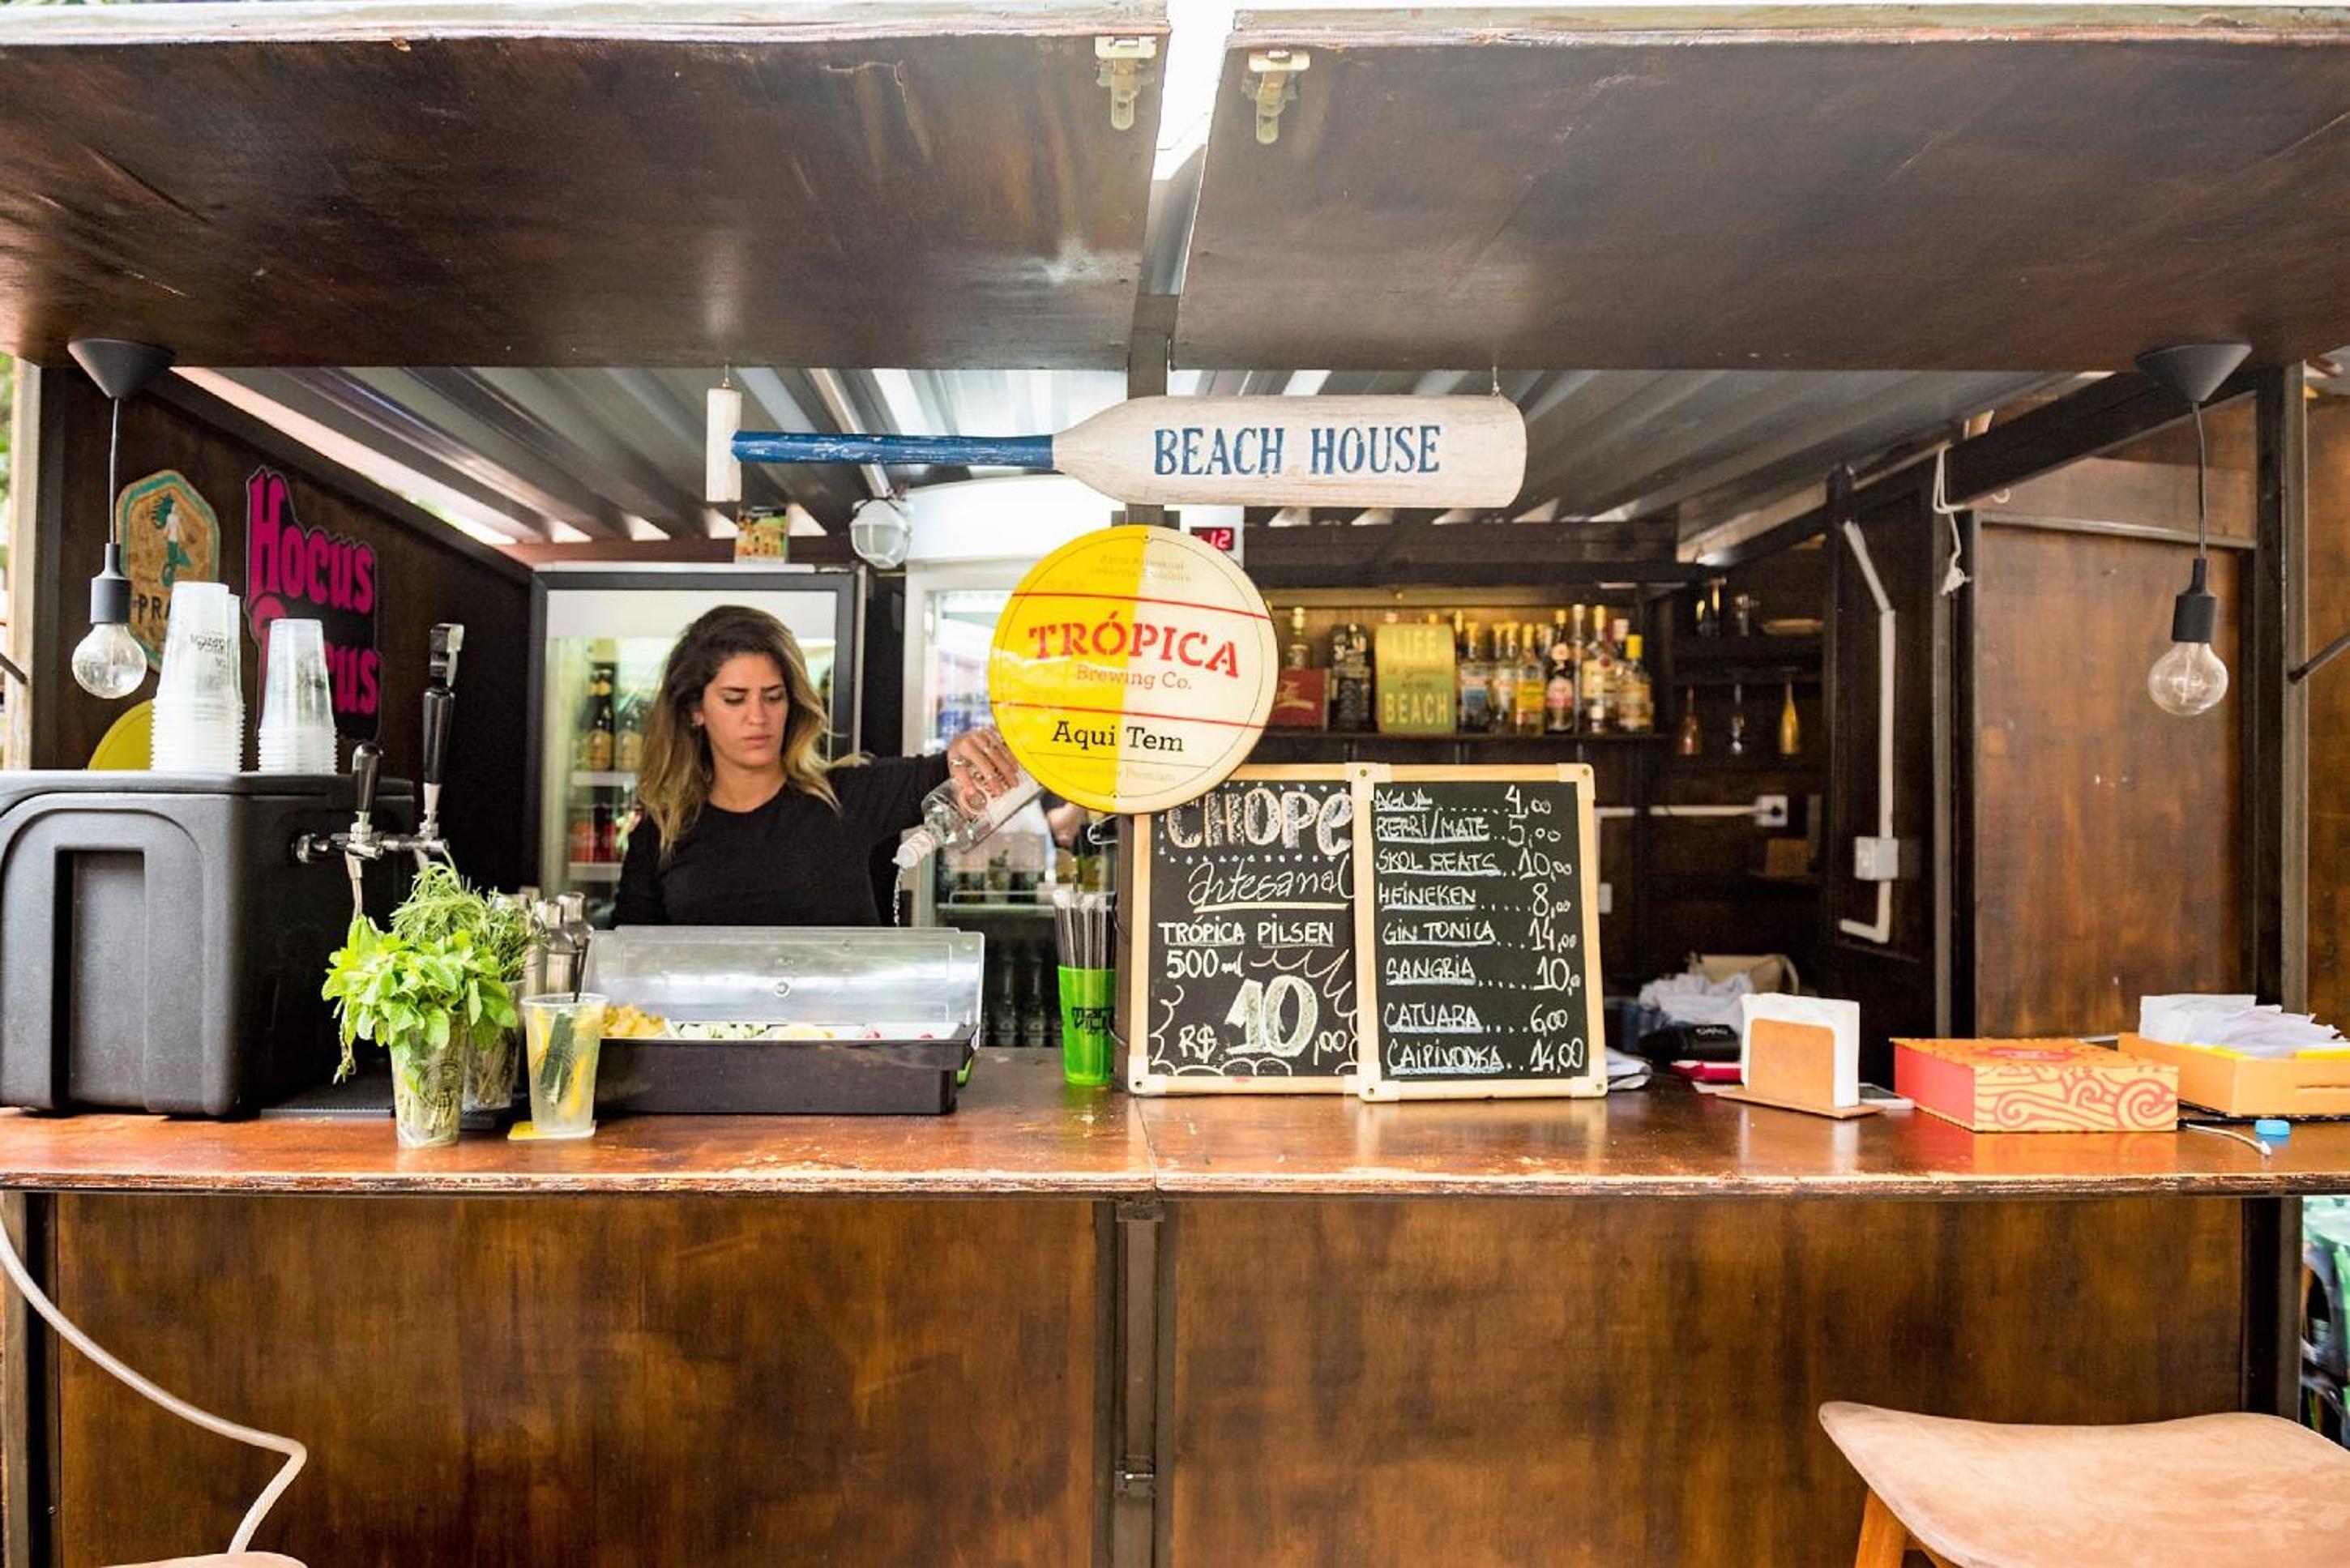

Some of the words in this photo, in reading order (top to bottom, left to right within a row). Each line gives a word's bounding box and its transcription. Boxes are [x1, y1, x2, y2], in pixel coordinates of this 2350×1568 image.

[1154, 426, 1285, 476] BEACH
[1310, 425, 1441, 474] HOUSE
[248, 474, 374, 614] Hocus
[1028, 610, 1240, 678] TRÓPICA
[1076, 664, 1156, 690] Brewing
[1161, 672, 1192, 690] Co.
[1384, 692, 1449, 725] BEACH
[1052, 720, 1117, 750] Aqui
[1126, 725, 1184, 752] Tem
[1376, 848, 1424, 871] SKOL
[1257, 913, 1335, 943] PILSEN
[1382, 918, 1417, 944] GIN
